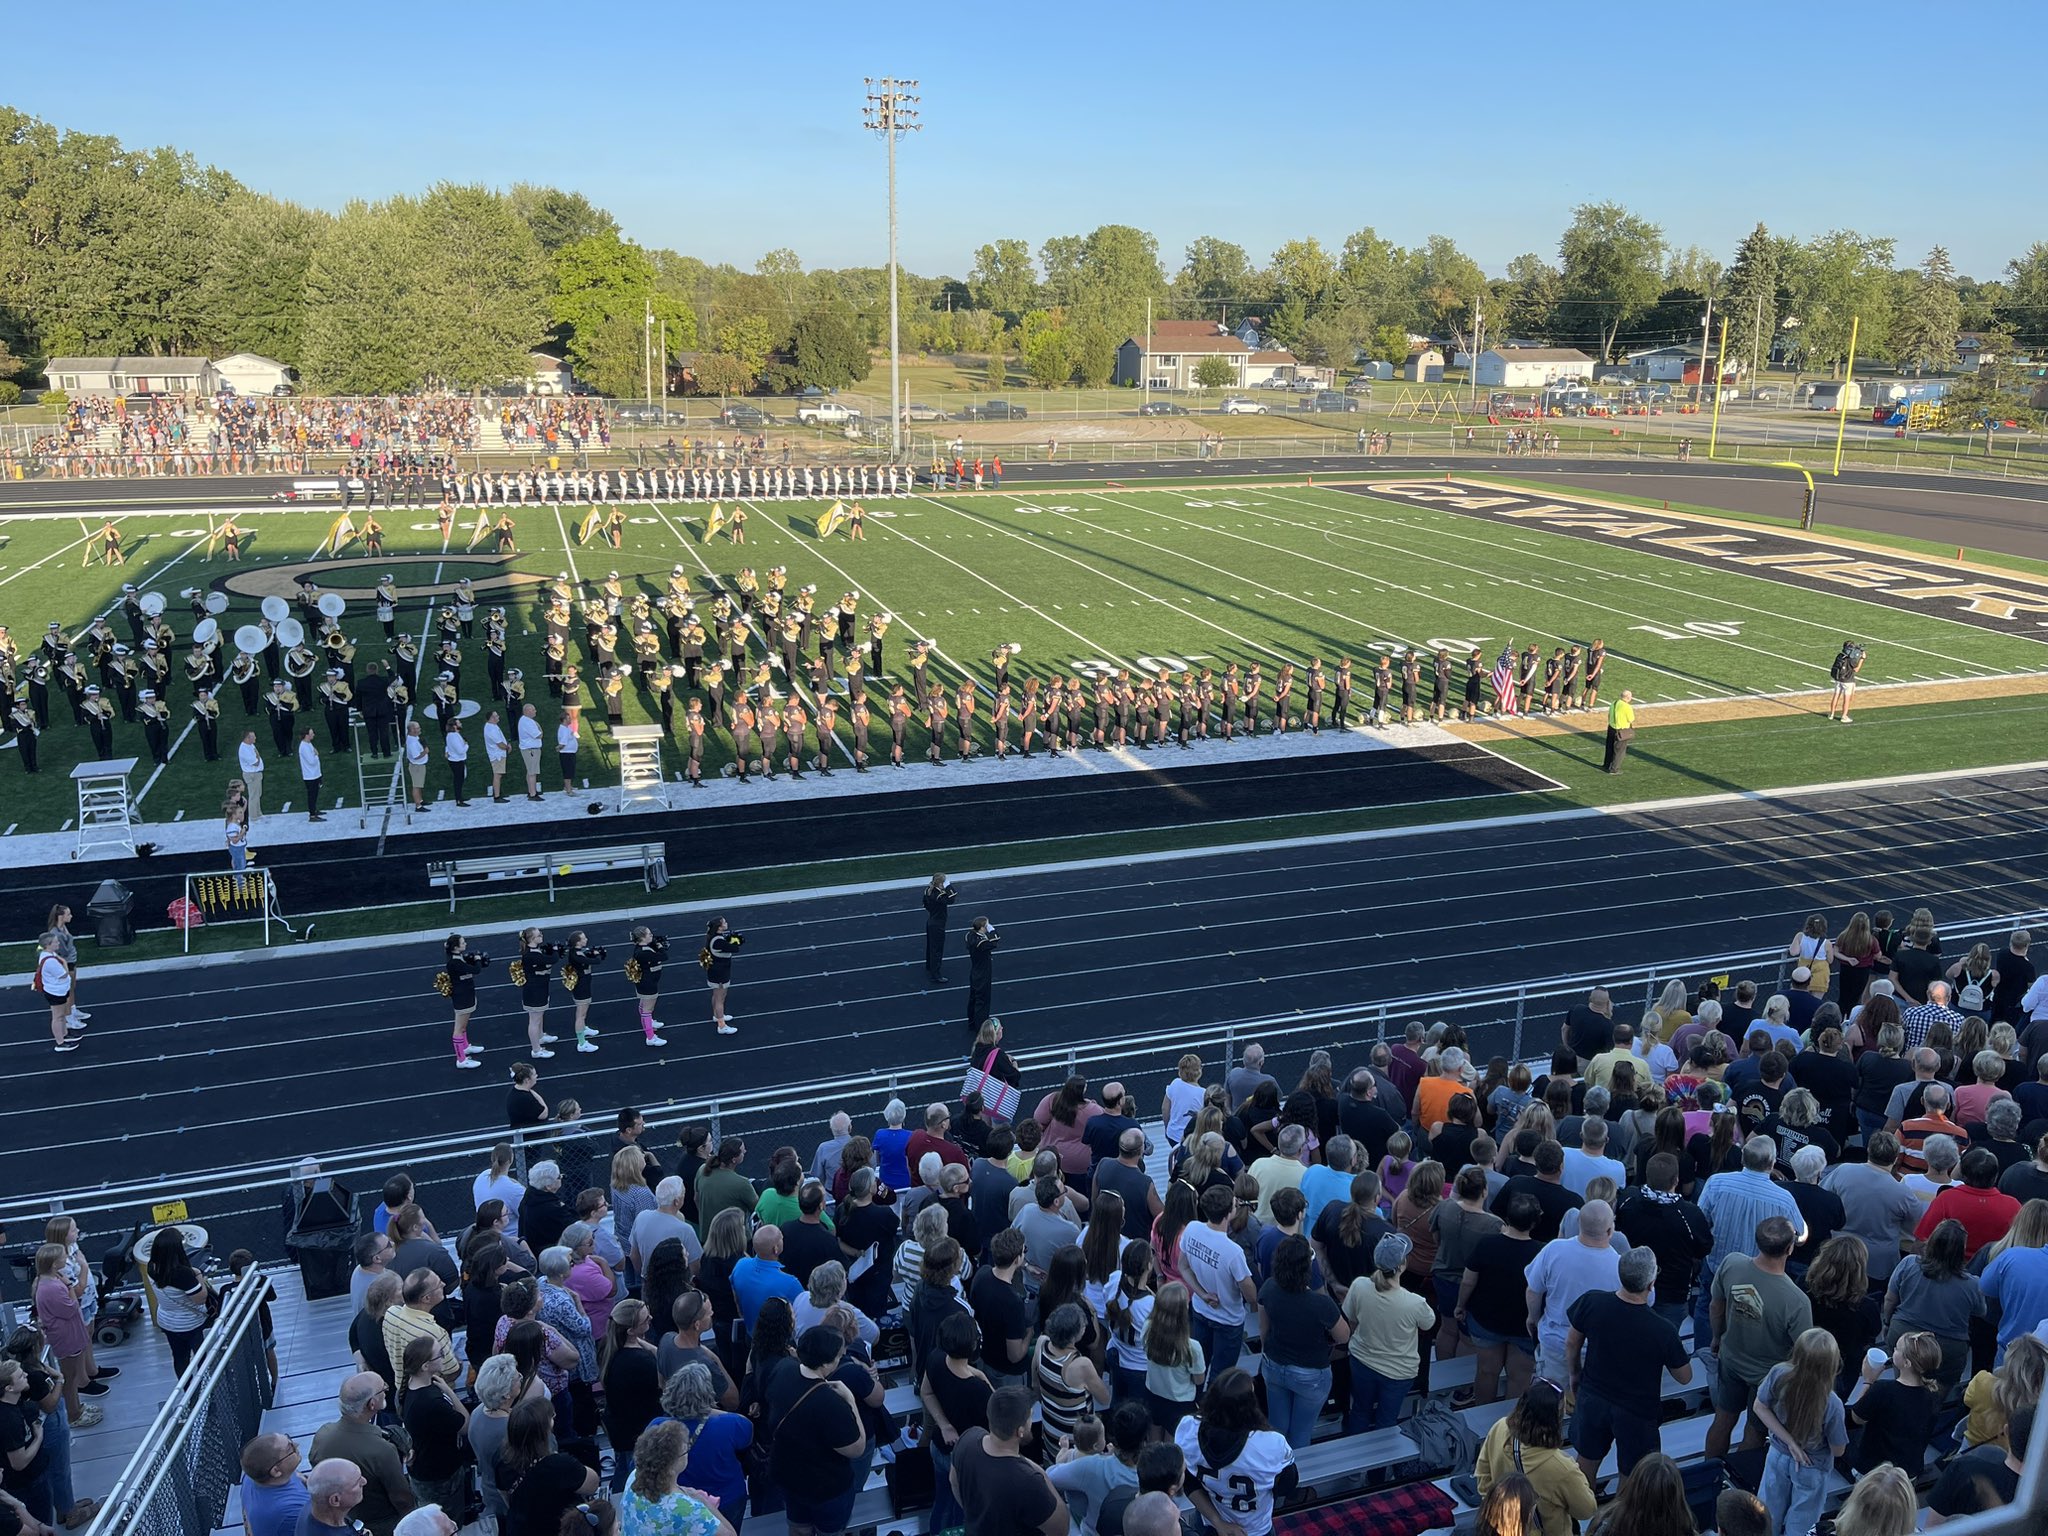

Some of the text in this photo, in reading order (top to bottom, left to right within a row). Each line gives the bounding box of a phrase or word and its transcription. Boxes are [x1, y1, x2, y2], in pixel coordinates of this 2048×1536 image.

[1366, 482, 2048, 626] CAVALIER
[1627, 614, 1740, 640] 10
[1367, 637, 1480, 658] 20
[1070, 656, 1189, 678] 30
[1213, 1251, 1220, 1260] OF
